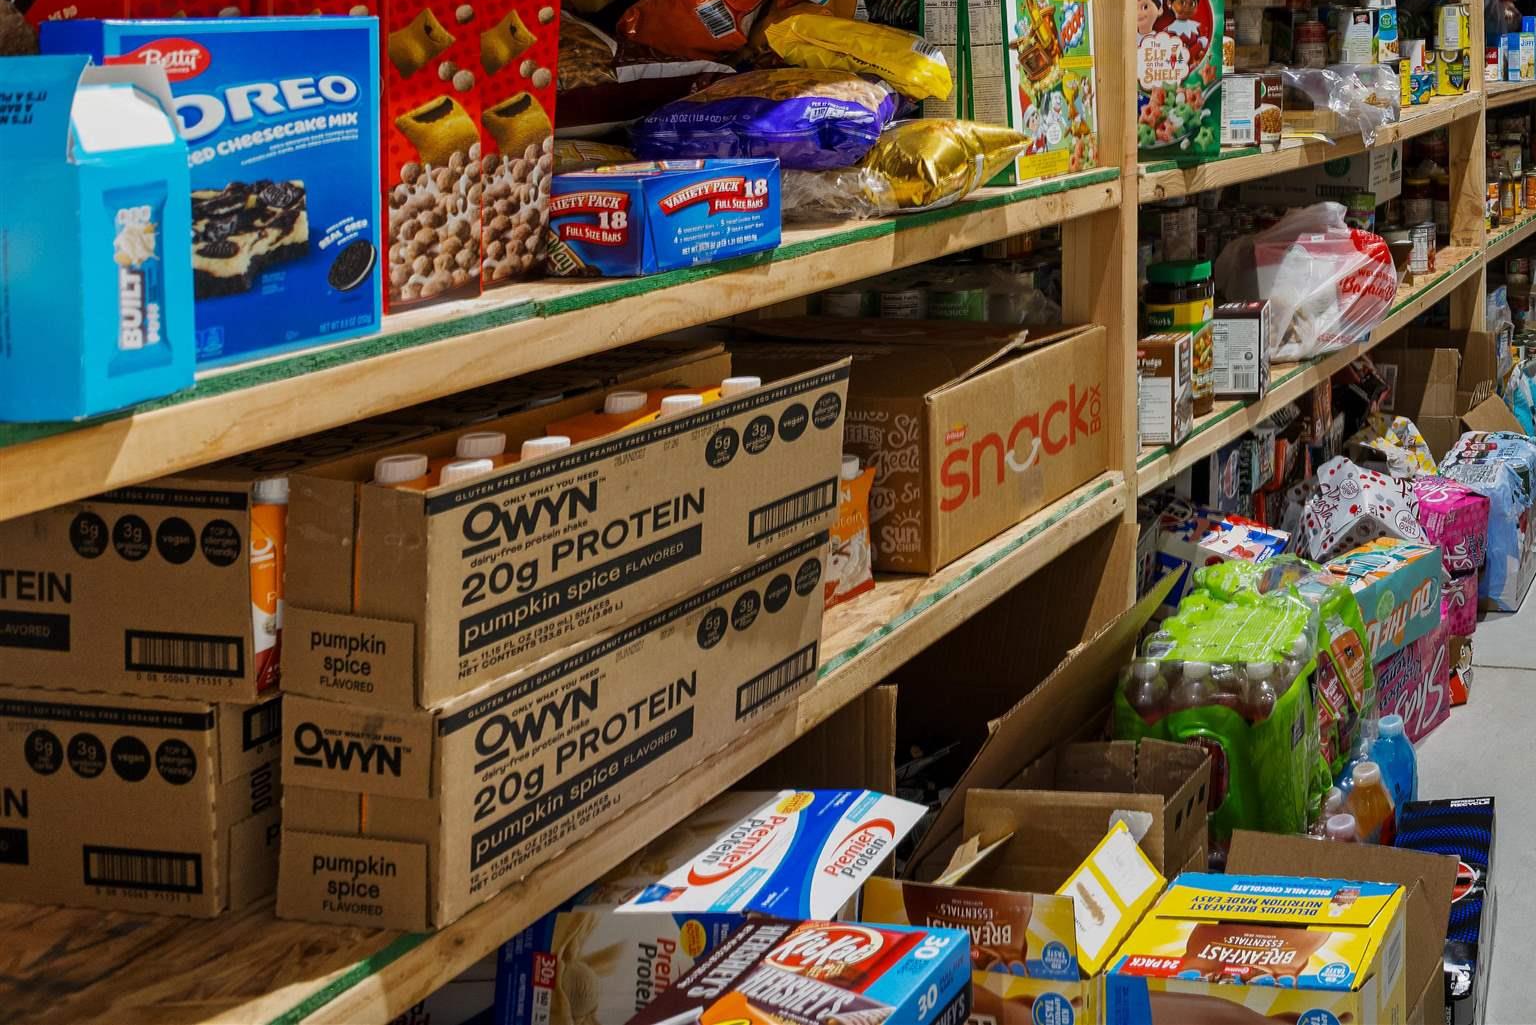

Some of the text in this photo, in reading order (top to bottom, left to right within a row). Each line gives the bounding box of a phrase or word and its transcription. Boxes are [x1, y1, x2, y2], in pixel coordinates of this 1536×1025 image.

[139, 47, 201, 71] Betty
[170, 75, 358, 141] OREO
[328, 111, 358, 128] MIX
[664, 181, 739, 209] VARIETY PACK
[745, 179, 768, 198] 18
[588, 194, 620, 209] PACK
[715, 199, 763, 209] FULL SIZE BARS
[599, 211, 627, 229] 18
[566, 225, 622, 242] FULL SIZE BARS
[120, 269, 143, 350] BUILT
[1089, 383, 1101, 435] BOX
[751, 423, 767, 437] 3g
[783, 416, 805, 428] vegan
[715, 436, 730, 449] 5g
[455, 485, 493, 501] GLUTEN
[498, 475, 521, 489] FREE
[530, 465, 557, 479] DAIRY
[560, 456, 581, 470] FREE
[589, 444, 620, 460] PEANUT
[653, 426, 672, 438] TREE
[674, 422, 690, 433] NUT
[503, 470, 599, 507] ONLY WHAT YOU NEED
[463, 480, 598, 542] OWYN
[162, 535, 190, 545] vegan
[462, 488, 705, 607] 20g PROTEIN
[470, 519, 588, 569] dairy-free protein shake
[464, 543, 684, 648] pumpkin spice FLAVORED
[575, 600, 610, 619] SHAKES
[310, 631, 386, 657] pumpkin
[482, 641, 537, 668] CONTENTS
[323, 655, 371, 676] spice
[320, 676, 374, 694] FLAVORED
[475, 679, 598, 757] OWYN
[294, 722, 402, 777] OWYN
[474, 670, 697, 823] 20g PROTEIN
[482, 752, 530, 783] dairy-free
[531, 733, 565, 757] protein
[475, 728, 677, 863] pumpkin spice FLAVORED
[702, 819, 766, 867] Protein
[719, 815, 788, 870] Premier
[823, 829, 876, 878] Premier
[312, 855, 396, 880] pumpkin
[841, 836, 888, 879] Protein
[327, 878, 380, 899] spice
[1294, 887, 1331, 897] RICH MILK
[938, 904, 993, 919] ESSENTIALS
[1190, 902, 1317, 916] DELICIOUS BREAKFAST
[1191, 895, 1323, 908] NUTRITION MADE EASY
[914, 935, 949, 959] 30
[1198, 944, 1297, 965] BREAKFAST
[1225, 936, 1285, 948] ESSENTIALS
[1167, 959, 1180, 970] 24
[737, 966, 857, 1019] HERSHEY'S
[918, 984, 938, 1020] 30
